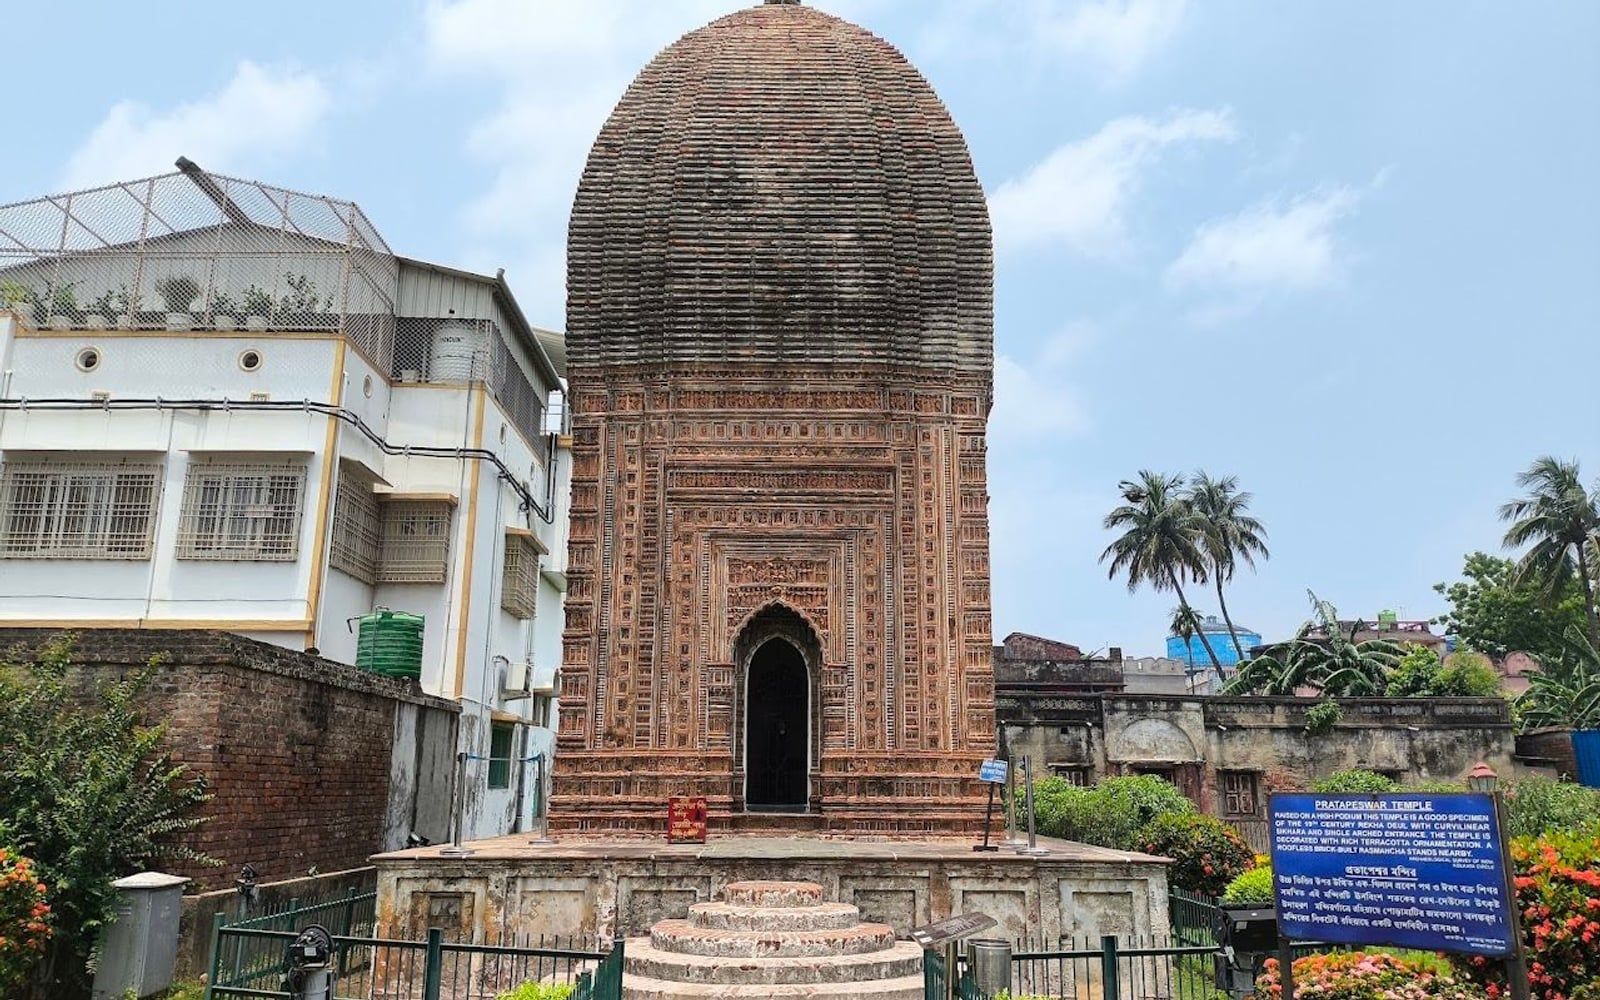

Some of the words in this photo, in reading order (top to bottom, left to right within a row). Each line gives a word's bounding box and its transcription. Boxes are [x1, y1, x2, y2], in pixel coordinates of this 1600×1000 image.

[1315, 800, 1387, 809] PRATAPESWAR
[1391, 801, 1432, 810] TEMPLE
[1320, 821, 1355, 829] CENTURY
[1433, 823, 1490, 831] CURVILINEAR
[1276, 828, 1306, 836] SIKHARA
[1324, 829, 1351, 837] SINGLE
[1447, 832, 1481, 840] TEMPLE
[1276, 836, 1319, 844] DECORATED
[1319, 837, 1340, 845] WITH
[1314, 846, 1359, 854] BRICK-BUILT
[1345, 866, 1388, 876] প্রতাপেশ্বর
[1390, 865, 1416, 877] মন্দির
